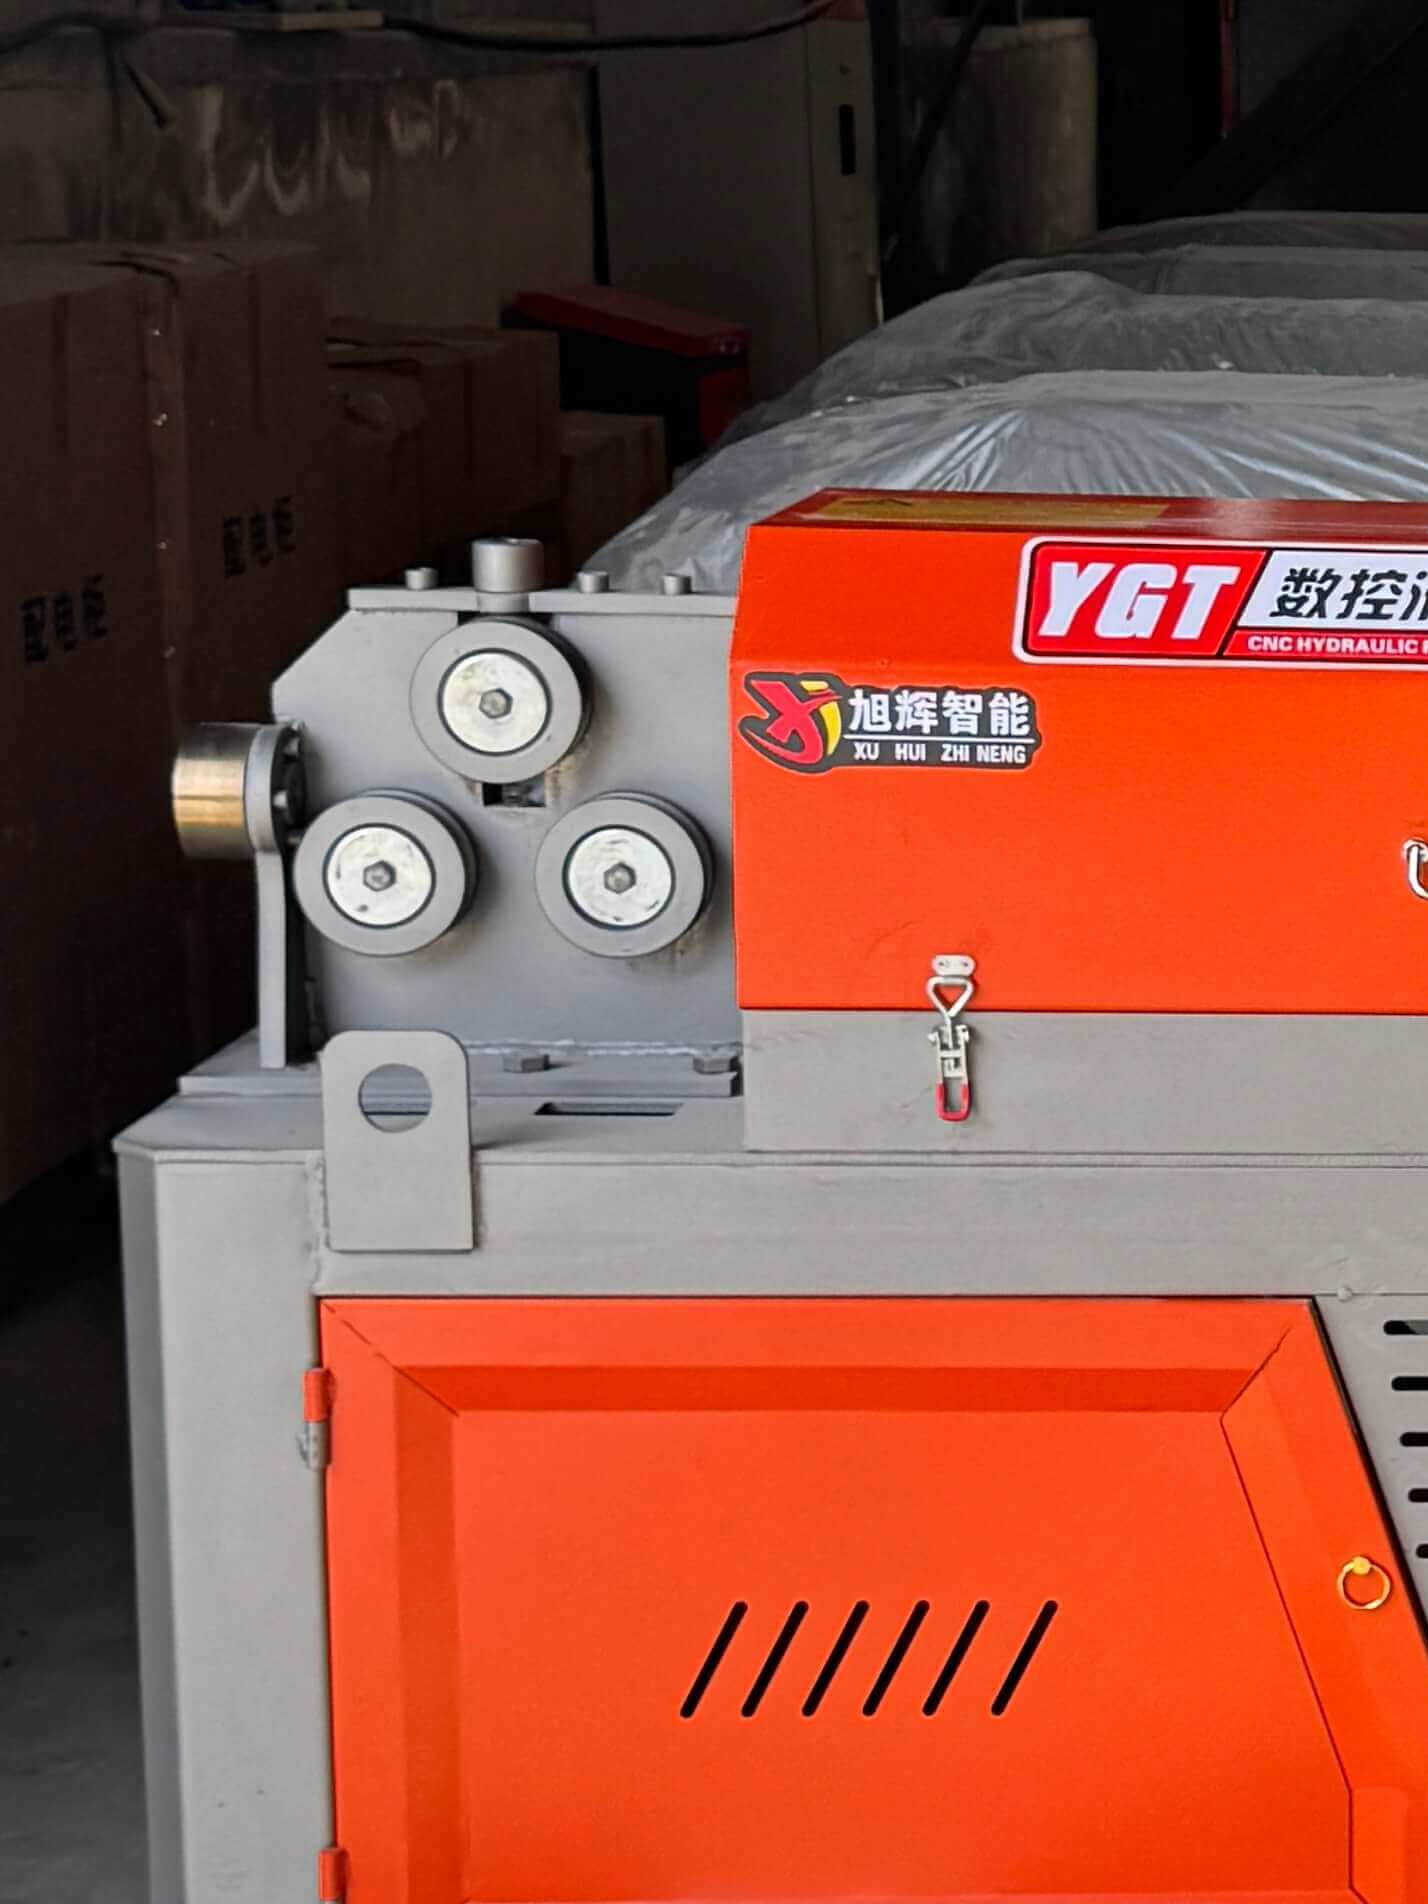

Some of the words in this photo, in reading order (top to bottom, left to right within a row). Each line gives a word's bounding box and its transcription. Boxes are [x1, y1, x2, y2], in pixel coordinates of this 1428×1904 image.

[1038, 560, 1241, 640] YGT
[1248, 636, 1294, 653] CNC
[1296, 637, 1420, 656] HYDRAULIC
[848, 687, 1030, 736] 旭辉智能
[853, 741, 880, 761] XU
[895, 742, 926, 762] HUI
[941, 743, 970, 763] ZHI
[976, 744, 1026, 764] NENG
